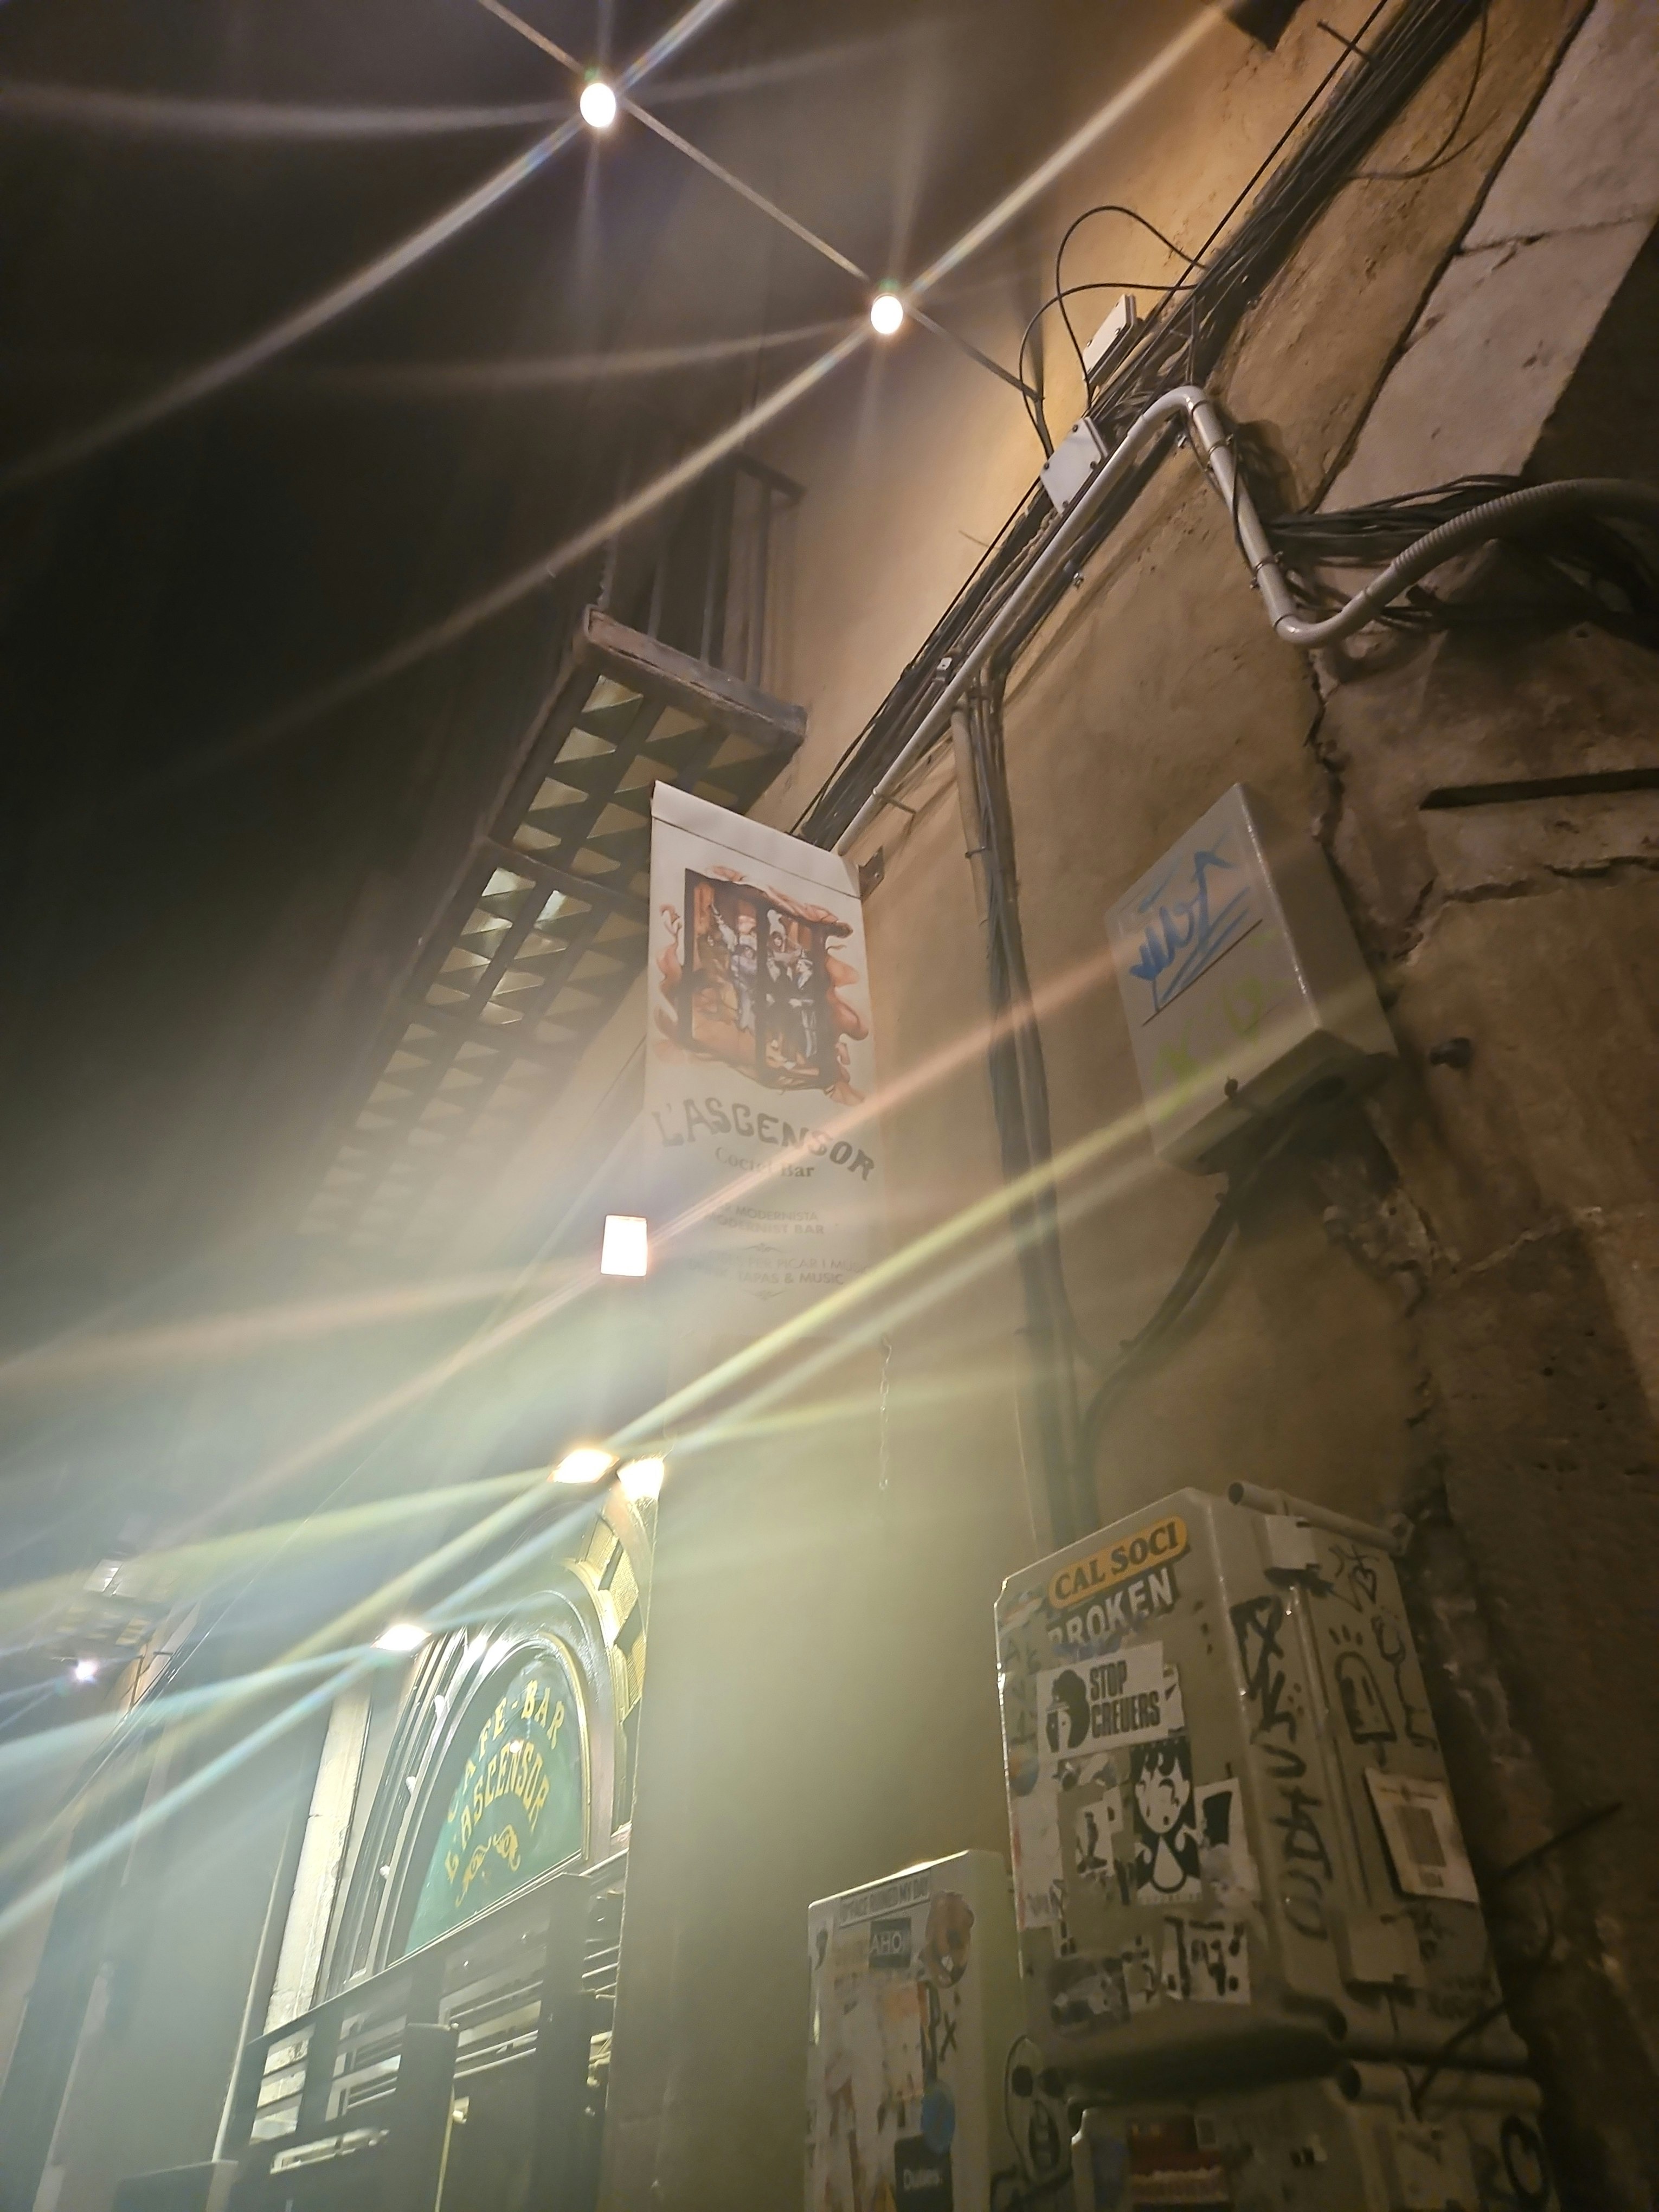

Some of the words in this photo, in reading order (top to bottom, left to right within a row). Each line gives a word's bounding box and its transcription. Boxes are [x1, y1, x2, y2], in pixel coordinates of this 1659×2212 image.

[651, 1097, 875, 1180] L'ASCENSOR
[781, 1162, 815, 1177] Bar
[735, 1205, 819, 1221] MODERNISTA
[794, 1224, 824, 1234] BAR
[799, 1272, 845, 1285] MUSIC
[1054, 1559, 1105, 1600] CAL
[1110, 1521, 1179, 1576] SOCI
[1089, 1660, 1128, 1700] STOP
